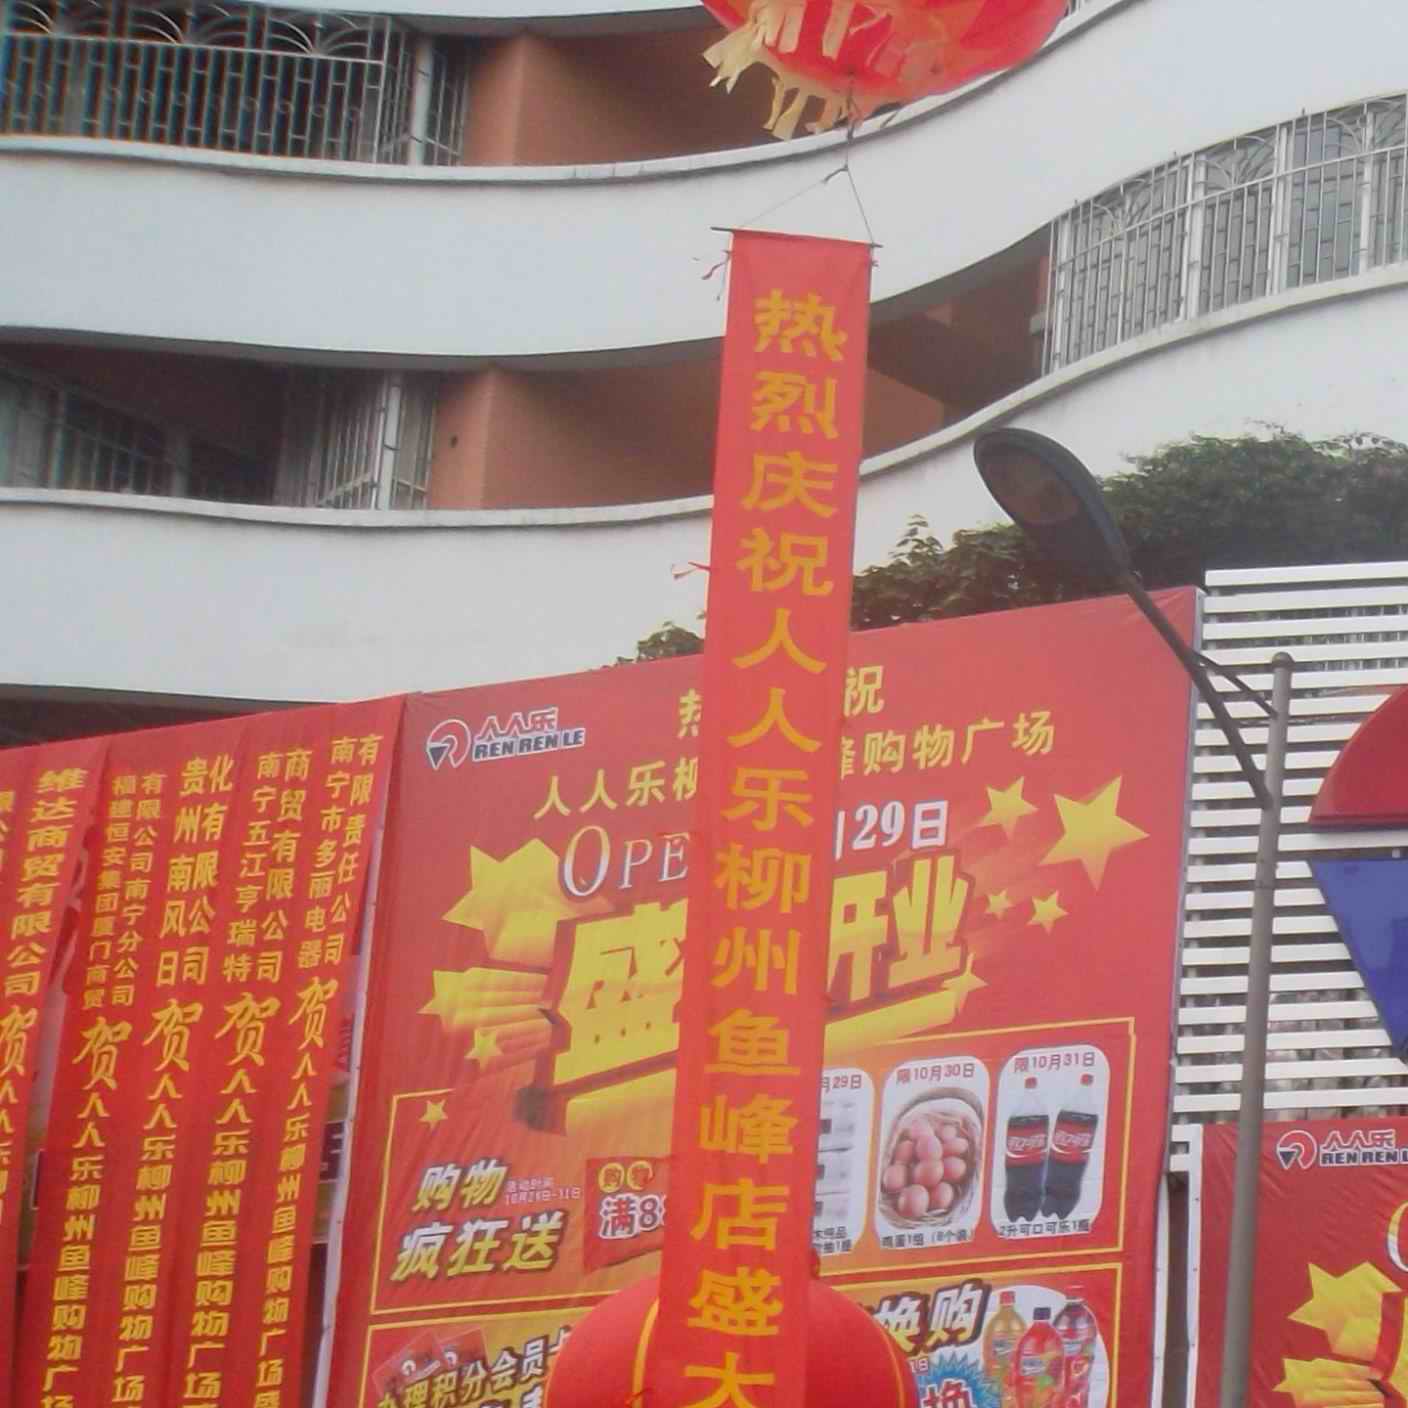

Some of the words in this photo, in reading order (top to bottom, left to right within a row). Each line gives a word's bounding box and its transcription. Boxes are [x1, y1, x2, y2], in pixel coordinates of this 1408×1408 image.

[835, 800, 949, 860] 29日
[895, 1062, 976, 1083] 限10月30日
[1013, 1051, 1096, 1074] 限10月31日
[1319, 1128, 1396, 1152] 人人乐
[411, 1157, 509, 1214] 购物
[389, 1209, 570, 1284] 疯狂送
